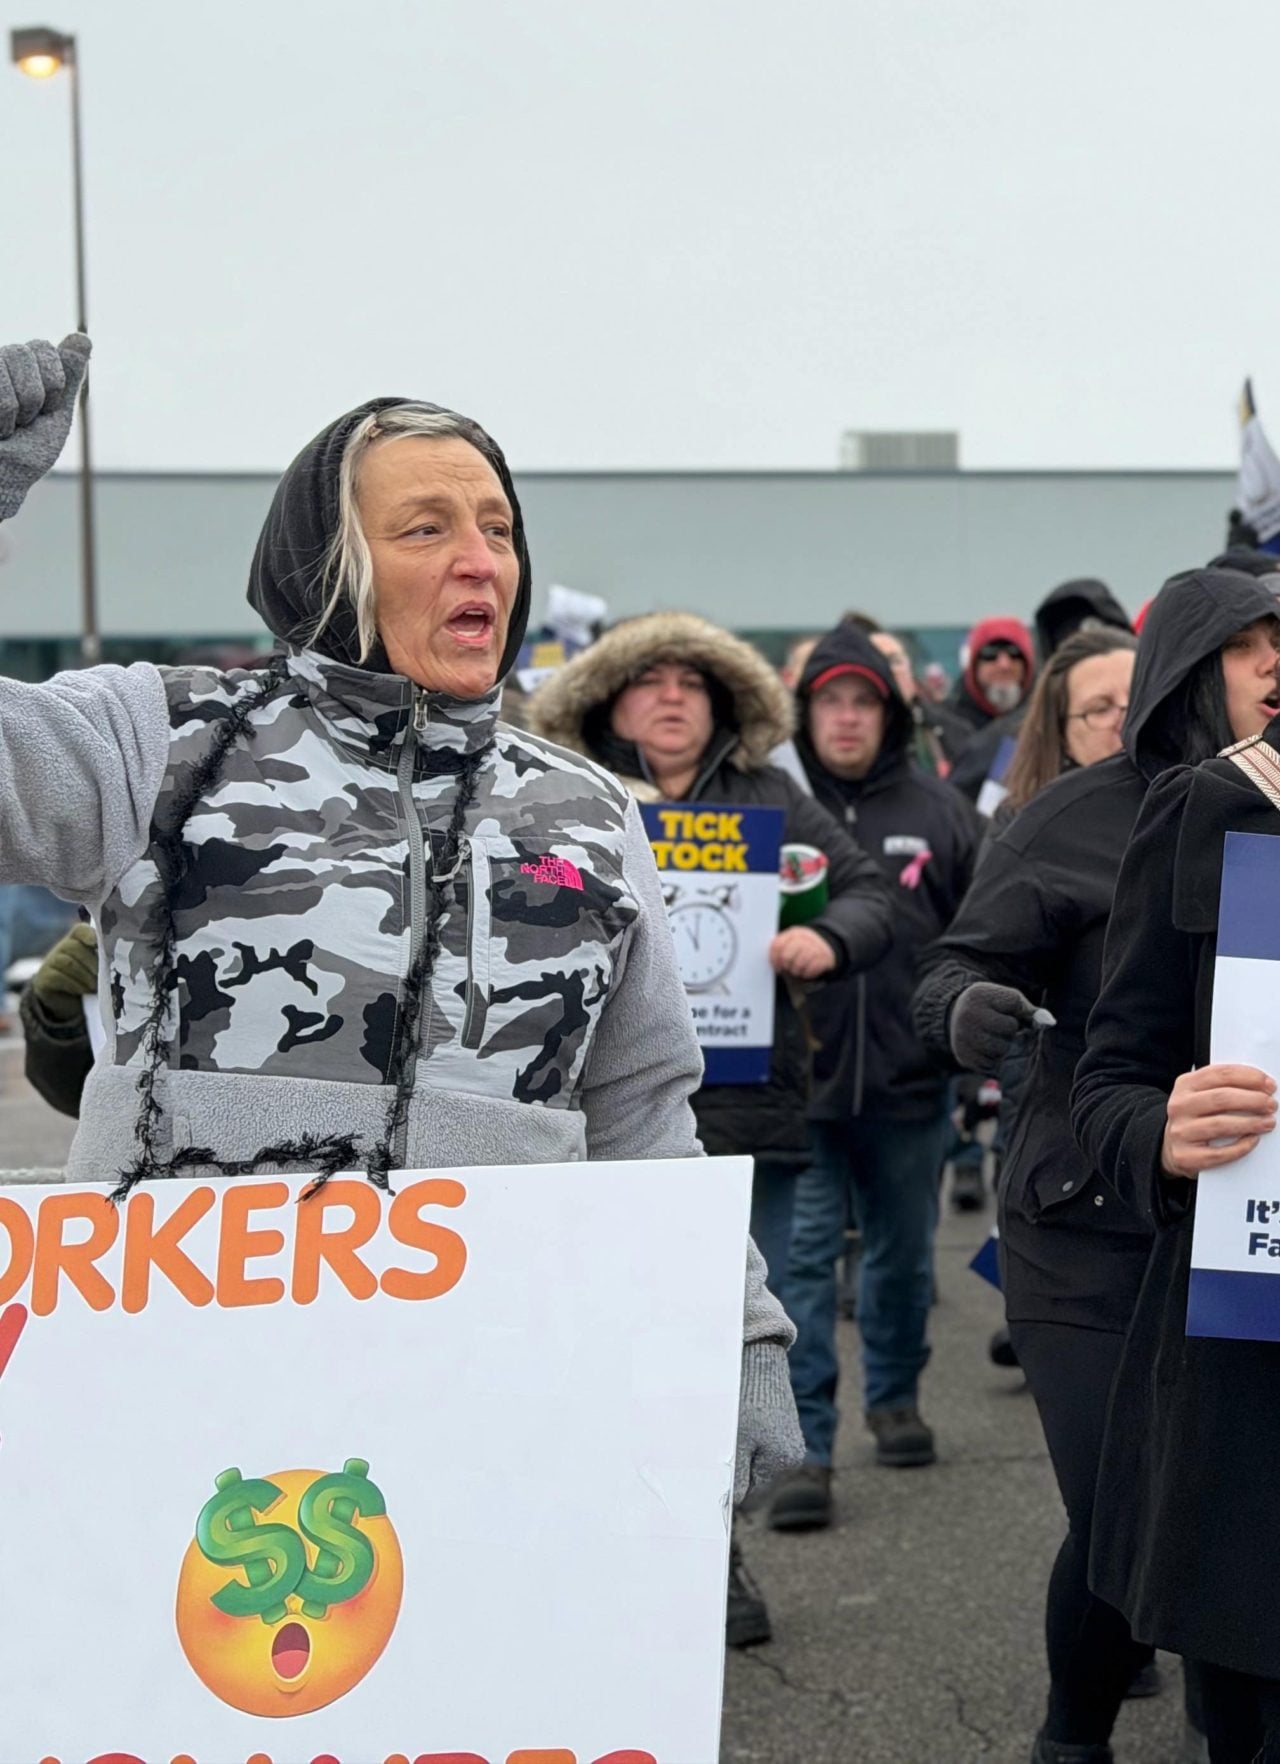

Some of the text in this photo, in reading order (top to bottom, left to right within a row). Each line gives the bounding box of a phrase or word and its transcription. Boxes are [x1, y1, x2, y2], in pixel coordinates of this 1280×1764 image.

[658, 810, 743, 841] TICK
[539, 855, 565, 867] THE
[650, 840, 749, 872] TOCK
[520, 862, 565, 877] NORTH
[534, 874, 567, 886] FACE
[696, 1025, 748, 1036] ntract
